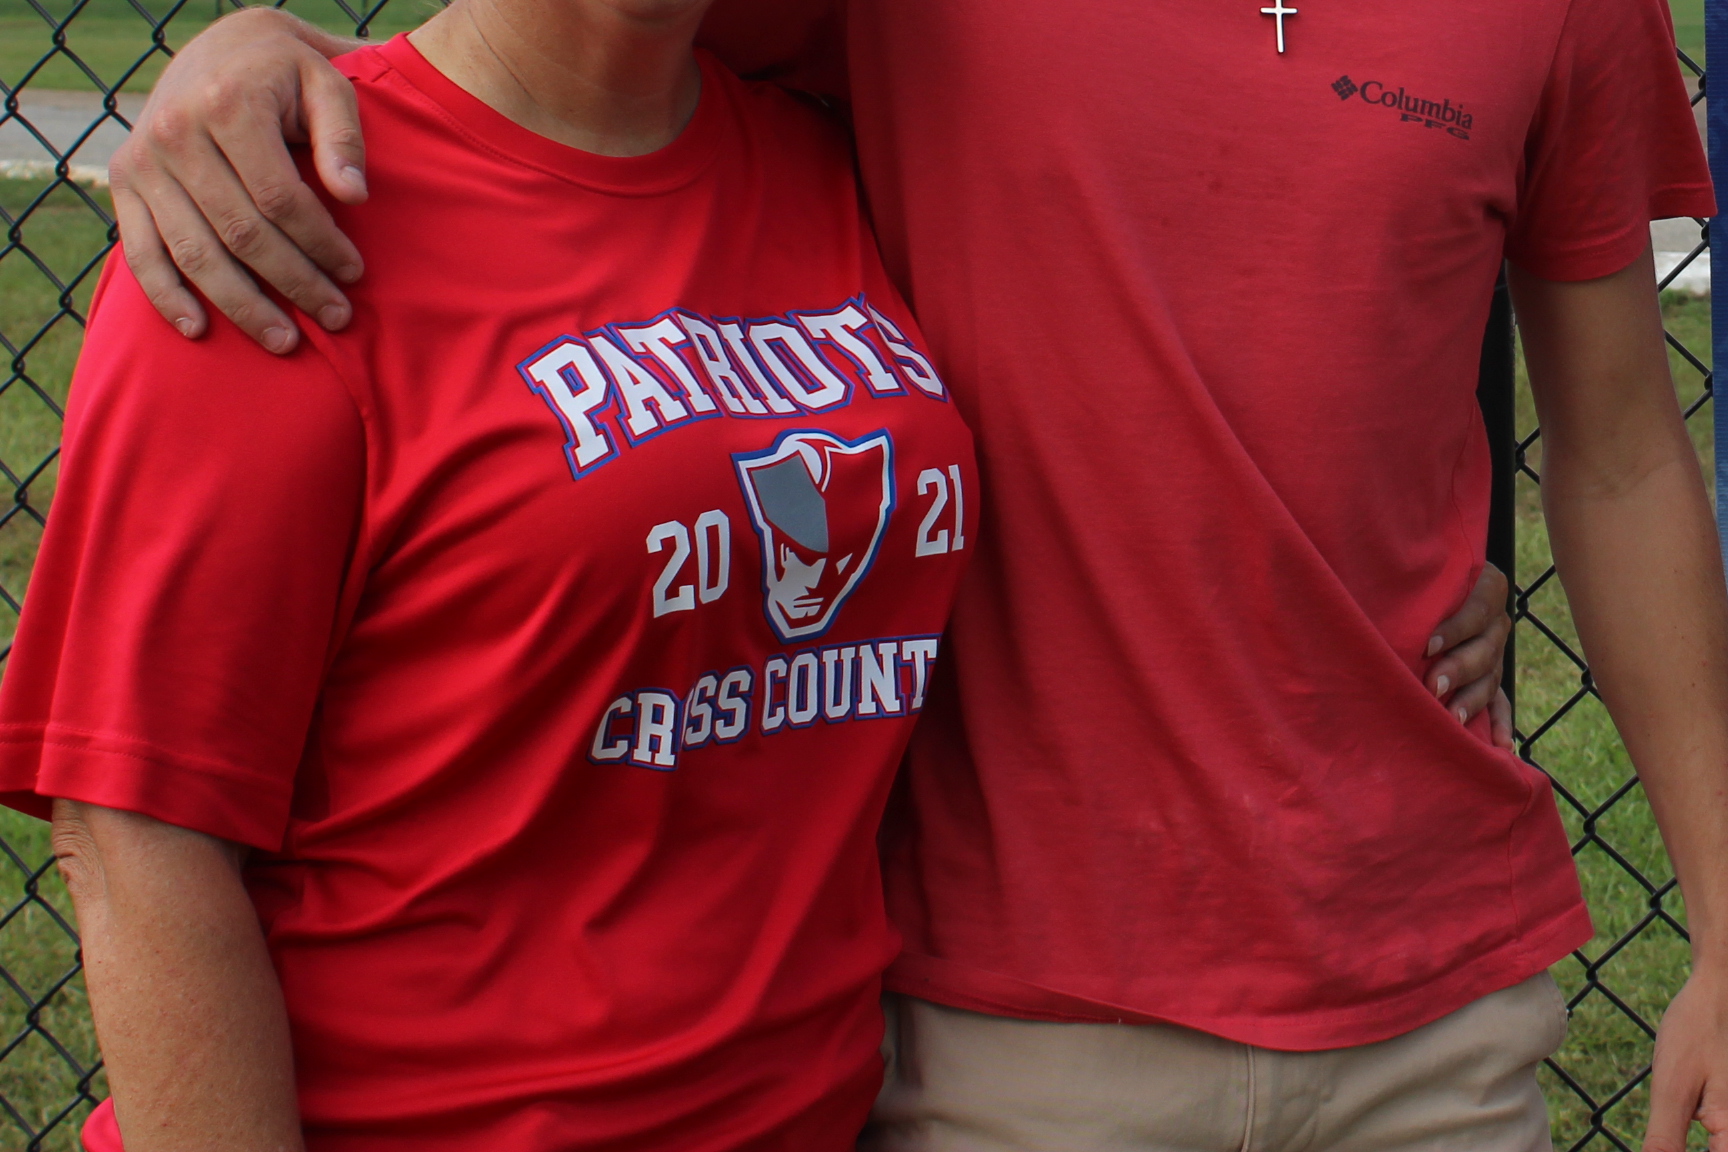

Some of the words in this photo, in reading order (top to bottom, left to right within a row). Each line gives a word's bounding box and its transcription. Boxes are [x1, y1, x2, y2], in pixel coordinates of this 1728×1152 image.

[1359, 80, 1474, 131] Columbia
[1399, 112, 1471, 141] PFG
[516, 292, 949, 481] PATRIOTS
[587, 664, 756, 772] CRSS
